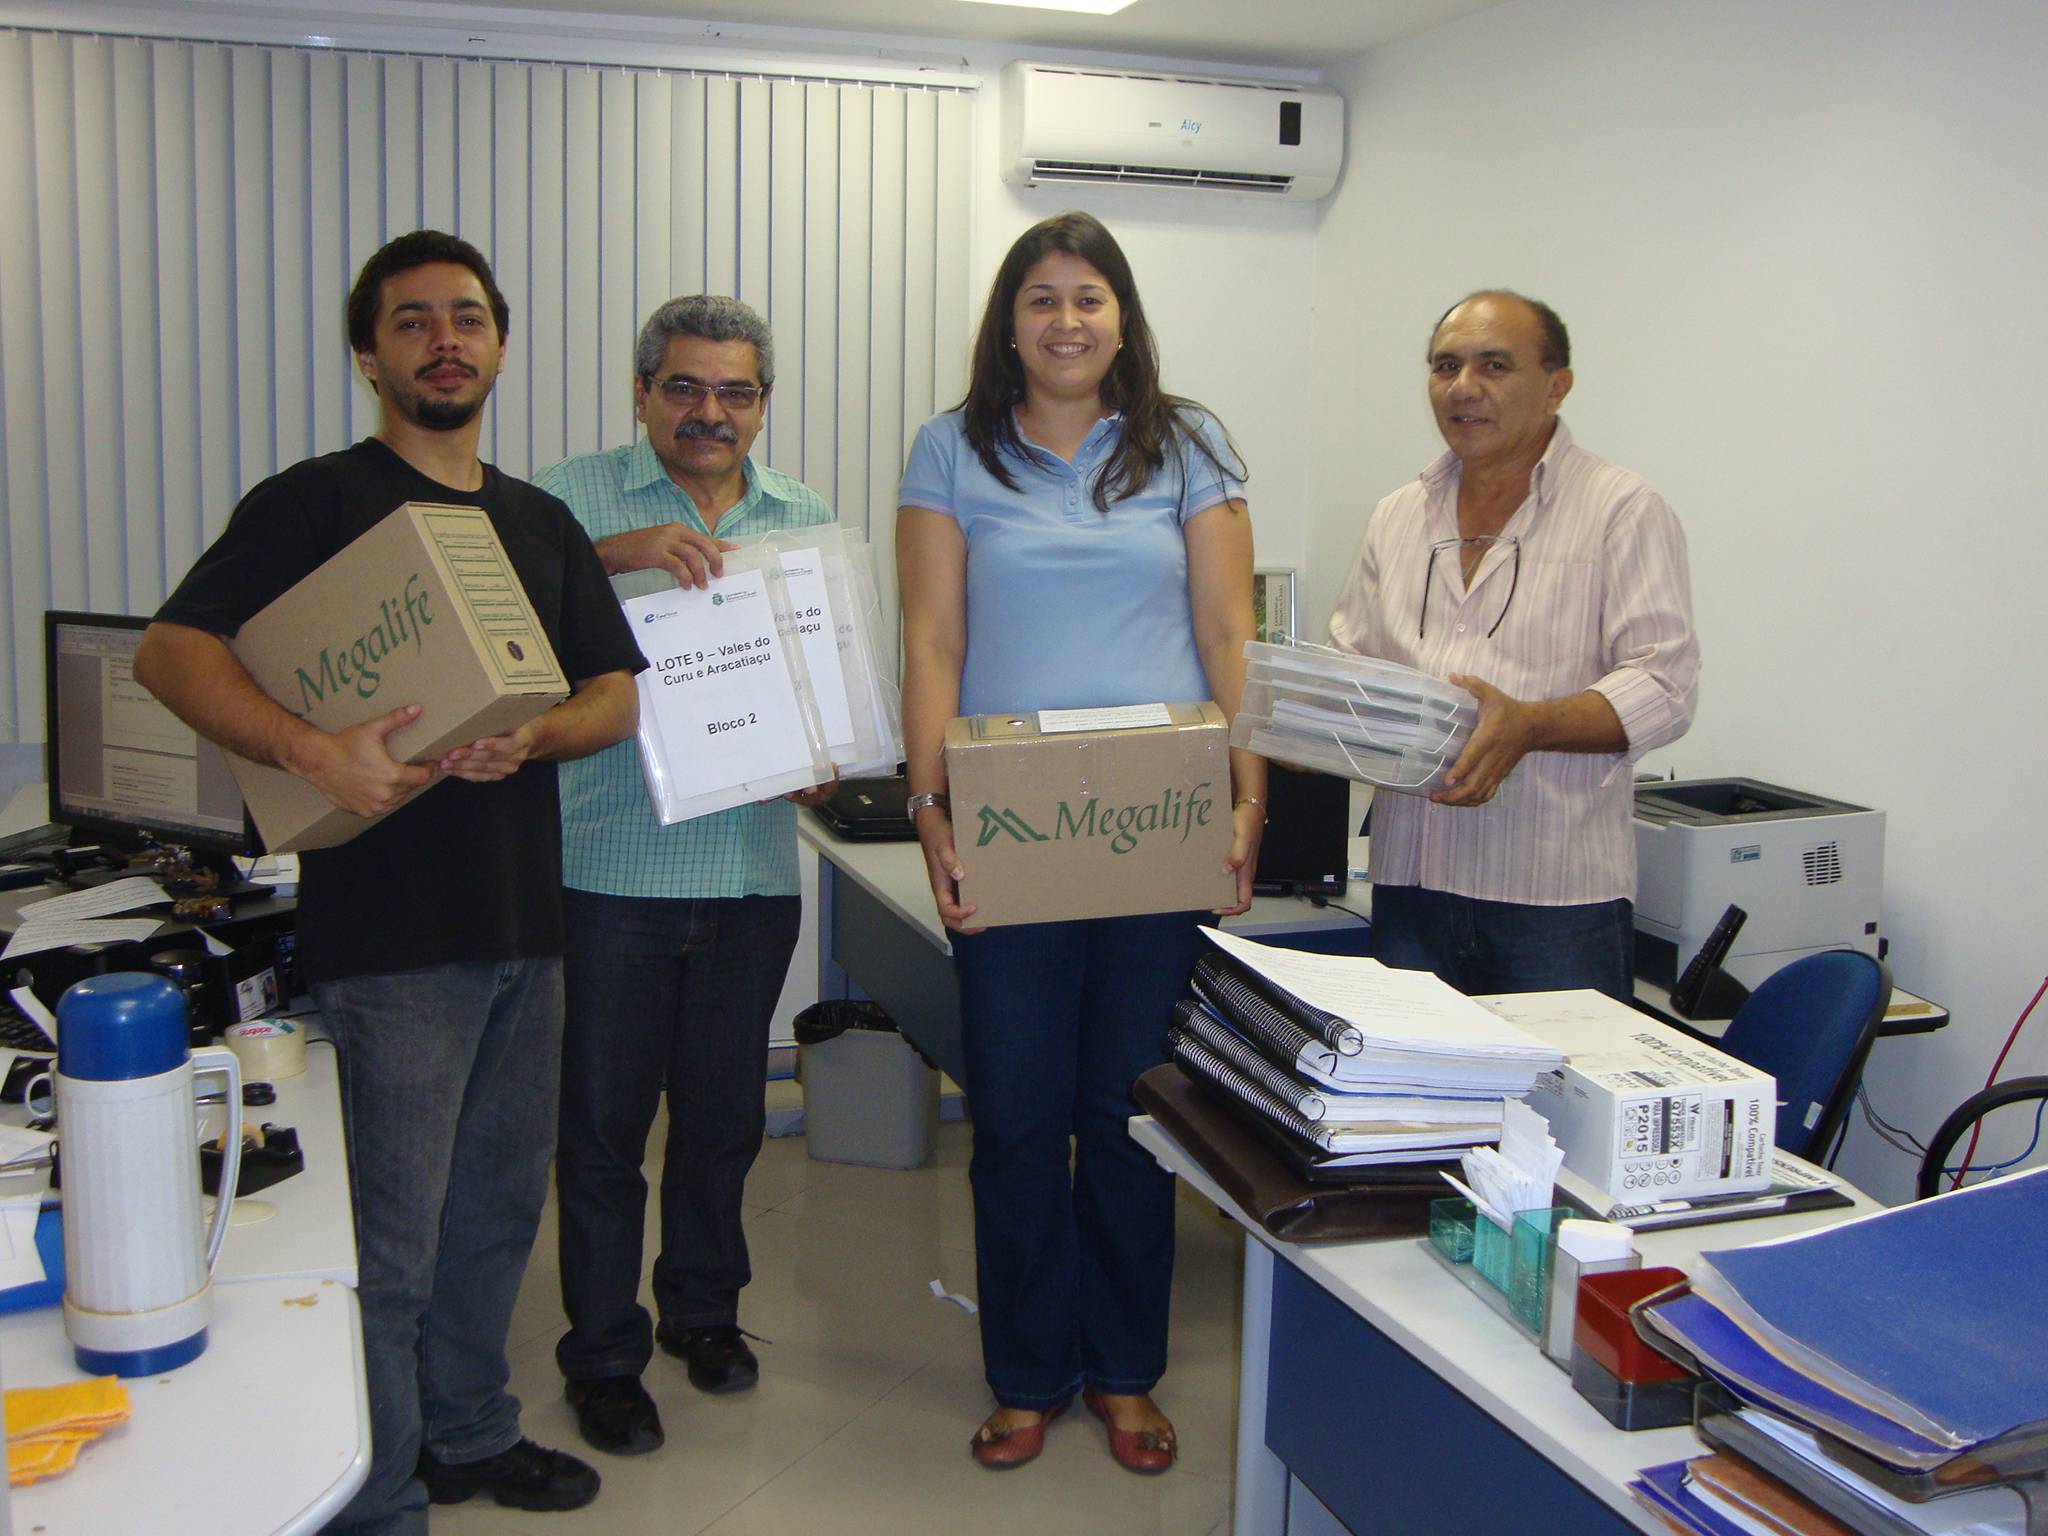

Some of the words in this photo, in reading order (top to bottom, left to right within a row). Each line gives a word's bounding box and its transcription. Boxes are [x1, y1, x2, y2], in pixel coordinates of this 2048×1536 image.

[806, 606, 821, 617] do
[294, 573, 434, 713] Megalife
[656, 653, 693, 672] LOTE
[695, 651, 704, 662] 9
[718, 641, 751, 657] Vales
[754, 636, 770, 648] do
[663, 672, 694, 686] Curu
[696, 669, 704, 678] e
[707, 652, 771, 676] Aracatiaçu
[707, 718, 746, 735] Bloco
[748, 712, 758, 724] 2
[1055, 782, 1212, 854] Megalife
[1637, 1104, 1649, 1152] P2015
[1671, 1101, 1681, 1148] Q7553X
[1748, 1098, 1760, 1126] 100%
